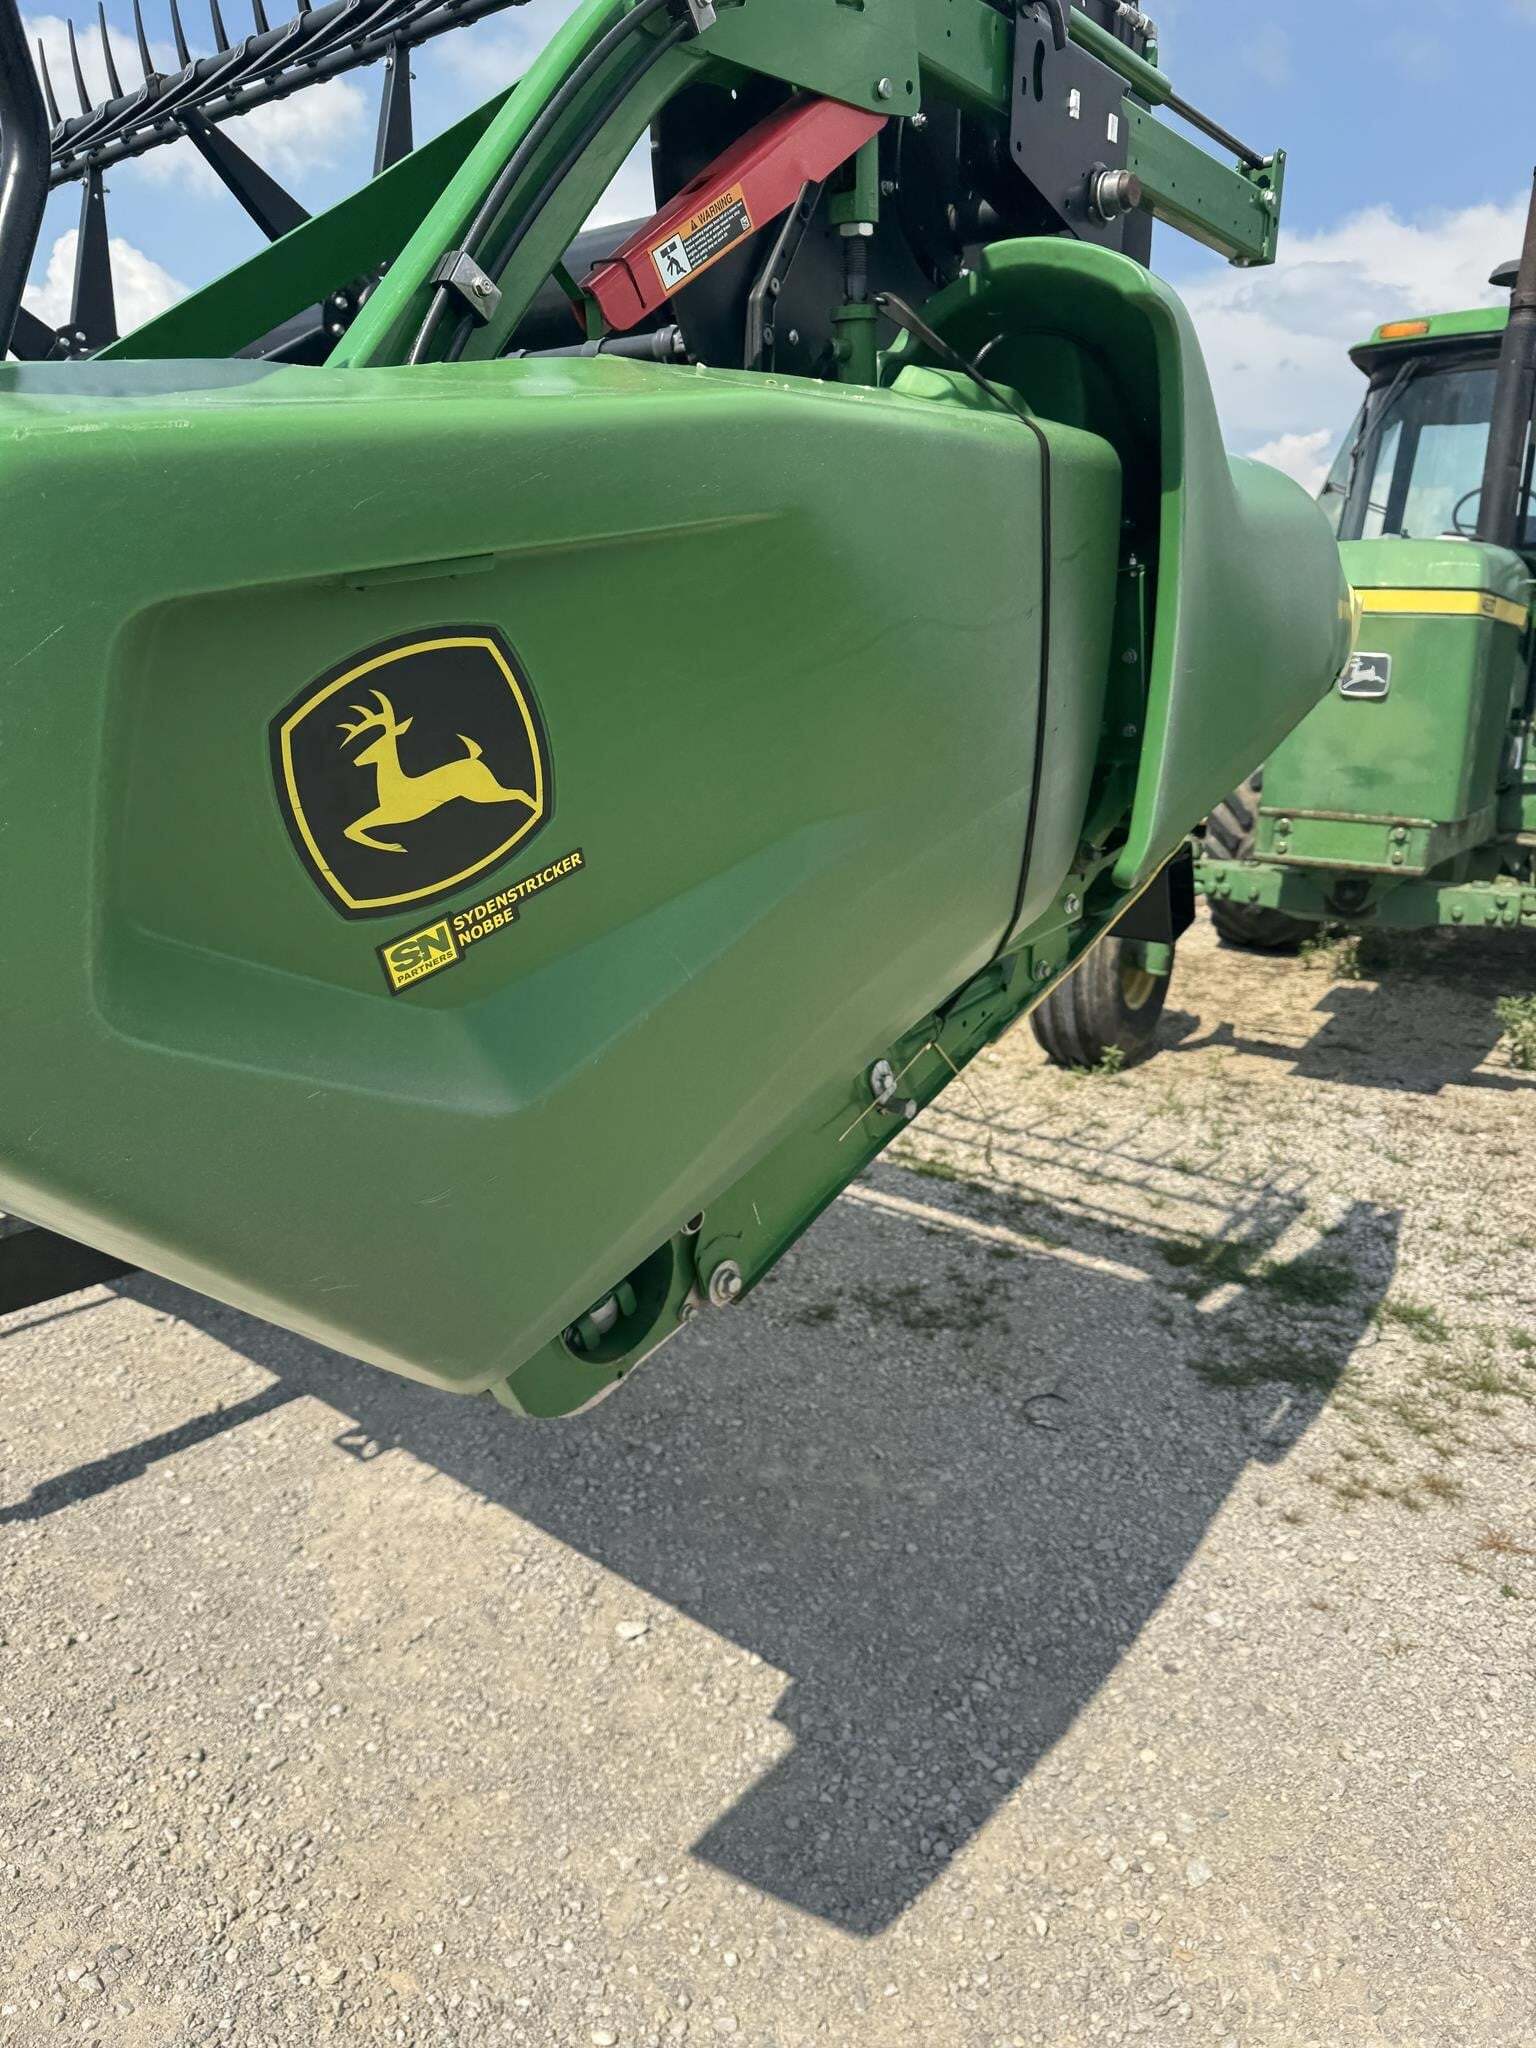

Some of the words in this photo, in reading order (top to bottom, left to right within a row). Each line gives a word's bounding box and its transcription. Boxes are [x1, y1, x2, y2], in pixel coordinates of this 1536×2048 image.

[697, 193, 733, 224] WARNING
[453, 853, 583, 931] SYDENSTRICKER
[457, 908, 514, 947] NOBBE
[397, 951, 454, 984] PARTNERS
